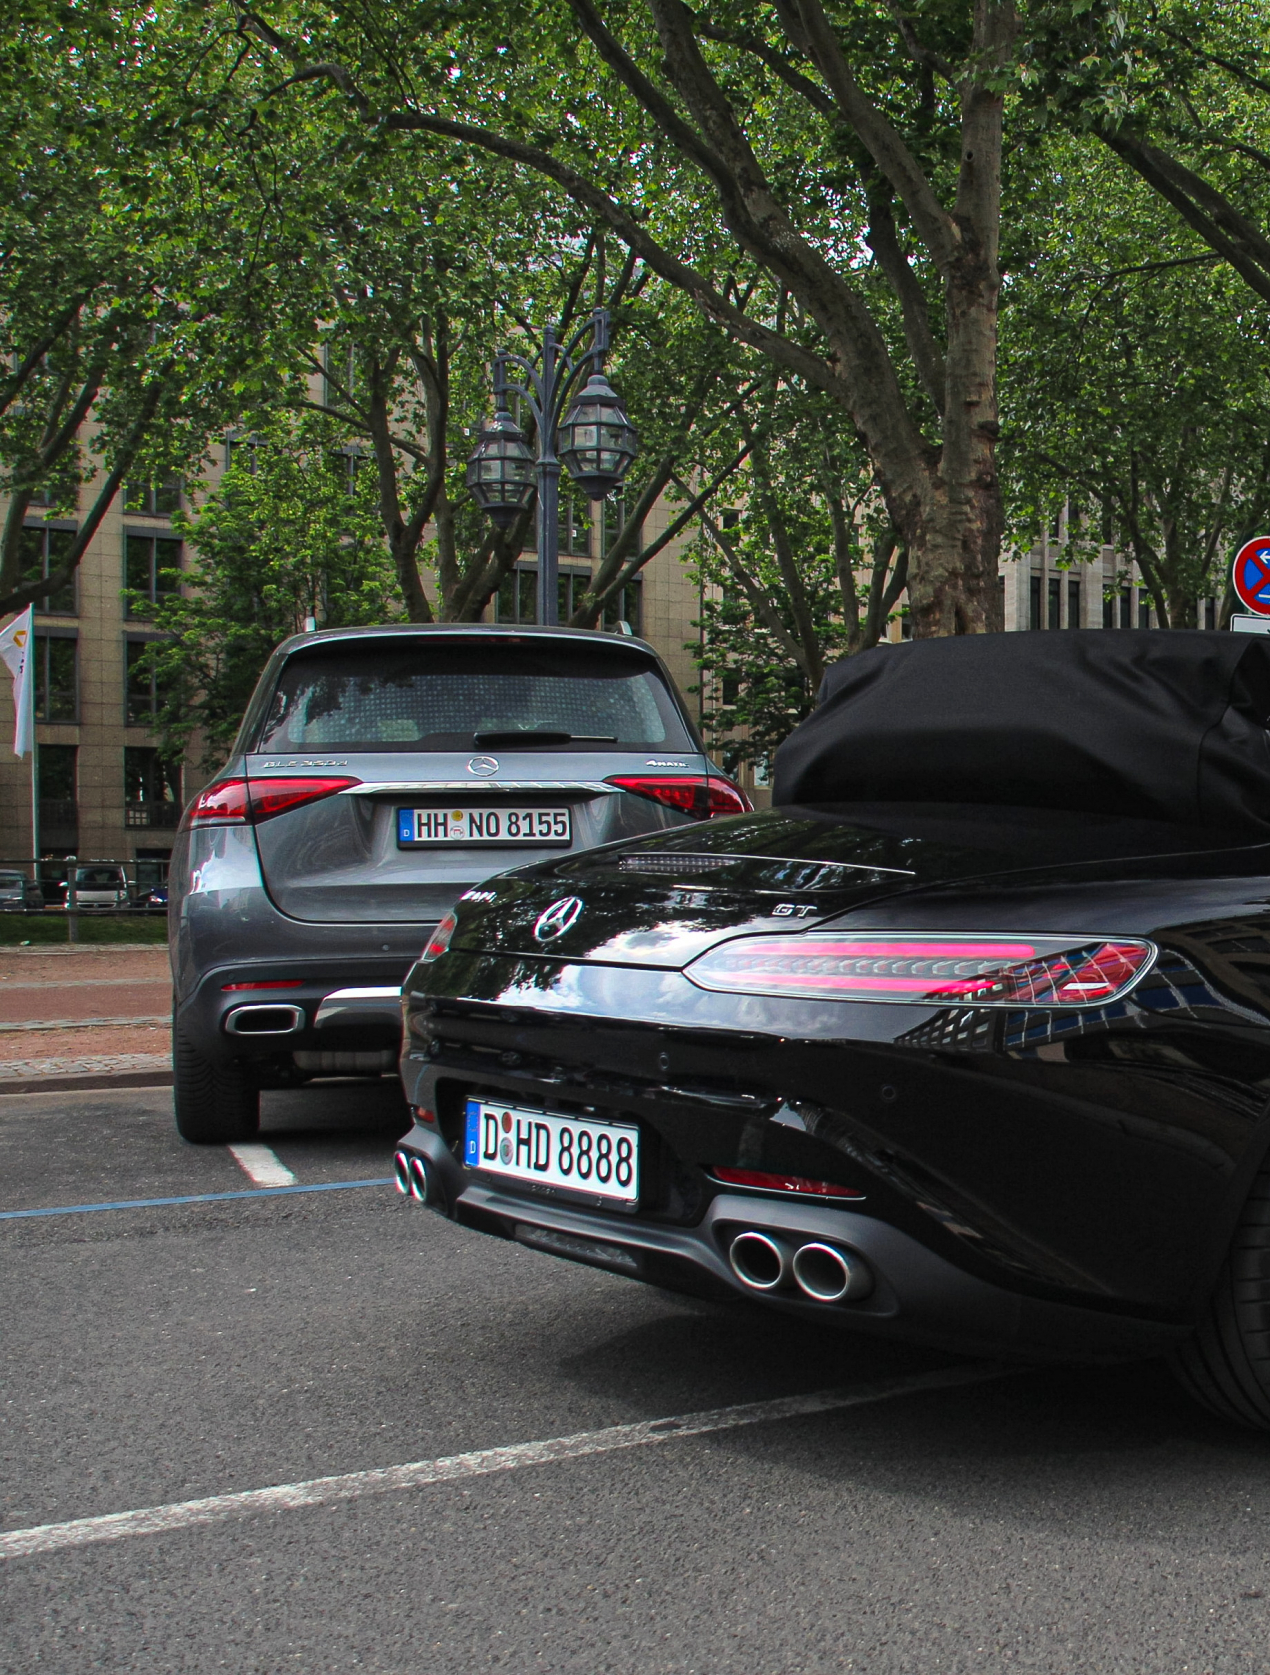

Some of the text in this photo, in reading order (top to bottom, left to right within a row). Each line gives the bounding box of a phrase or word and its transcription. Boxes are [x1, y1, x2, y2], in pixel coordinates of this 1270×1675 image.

[417, 811, 567, 838] HH NO 8155
[771, 903, 818, 917] GT
[483, 1112, 633, 1188] D HD 8888
